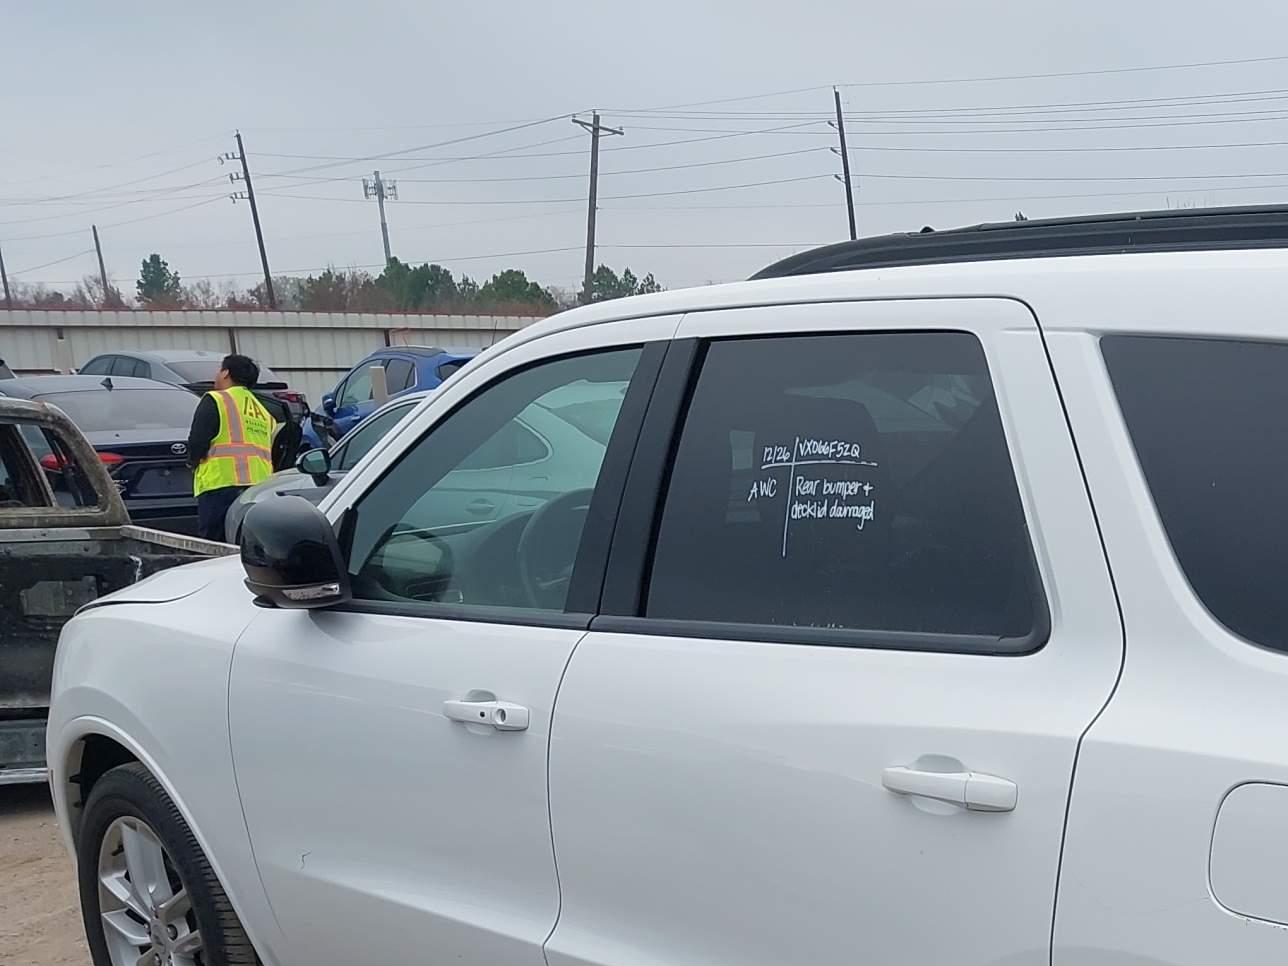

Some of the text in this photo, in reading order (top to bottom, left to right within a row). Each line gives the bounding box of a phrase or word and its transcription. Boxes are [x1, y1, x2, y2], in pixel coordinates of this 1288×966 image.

[763, 445, 791, 463] 12/26
[795, 476, 820, 496] Rear
[822, 478, 862, 500] bumper
